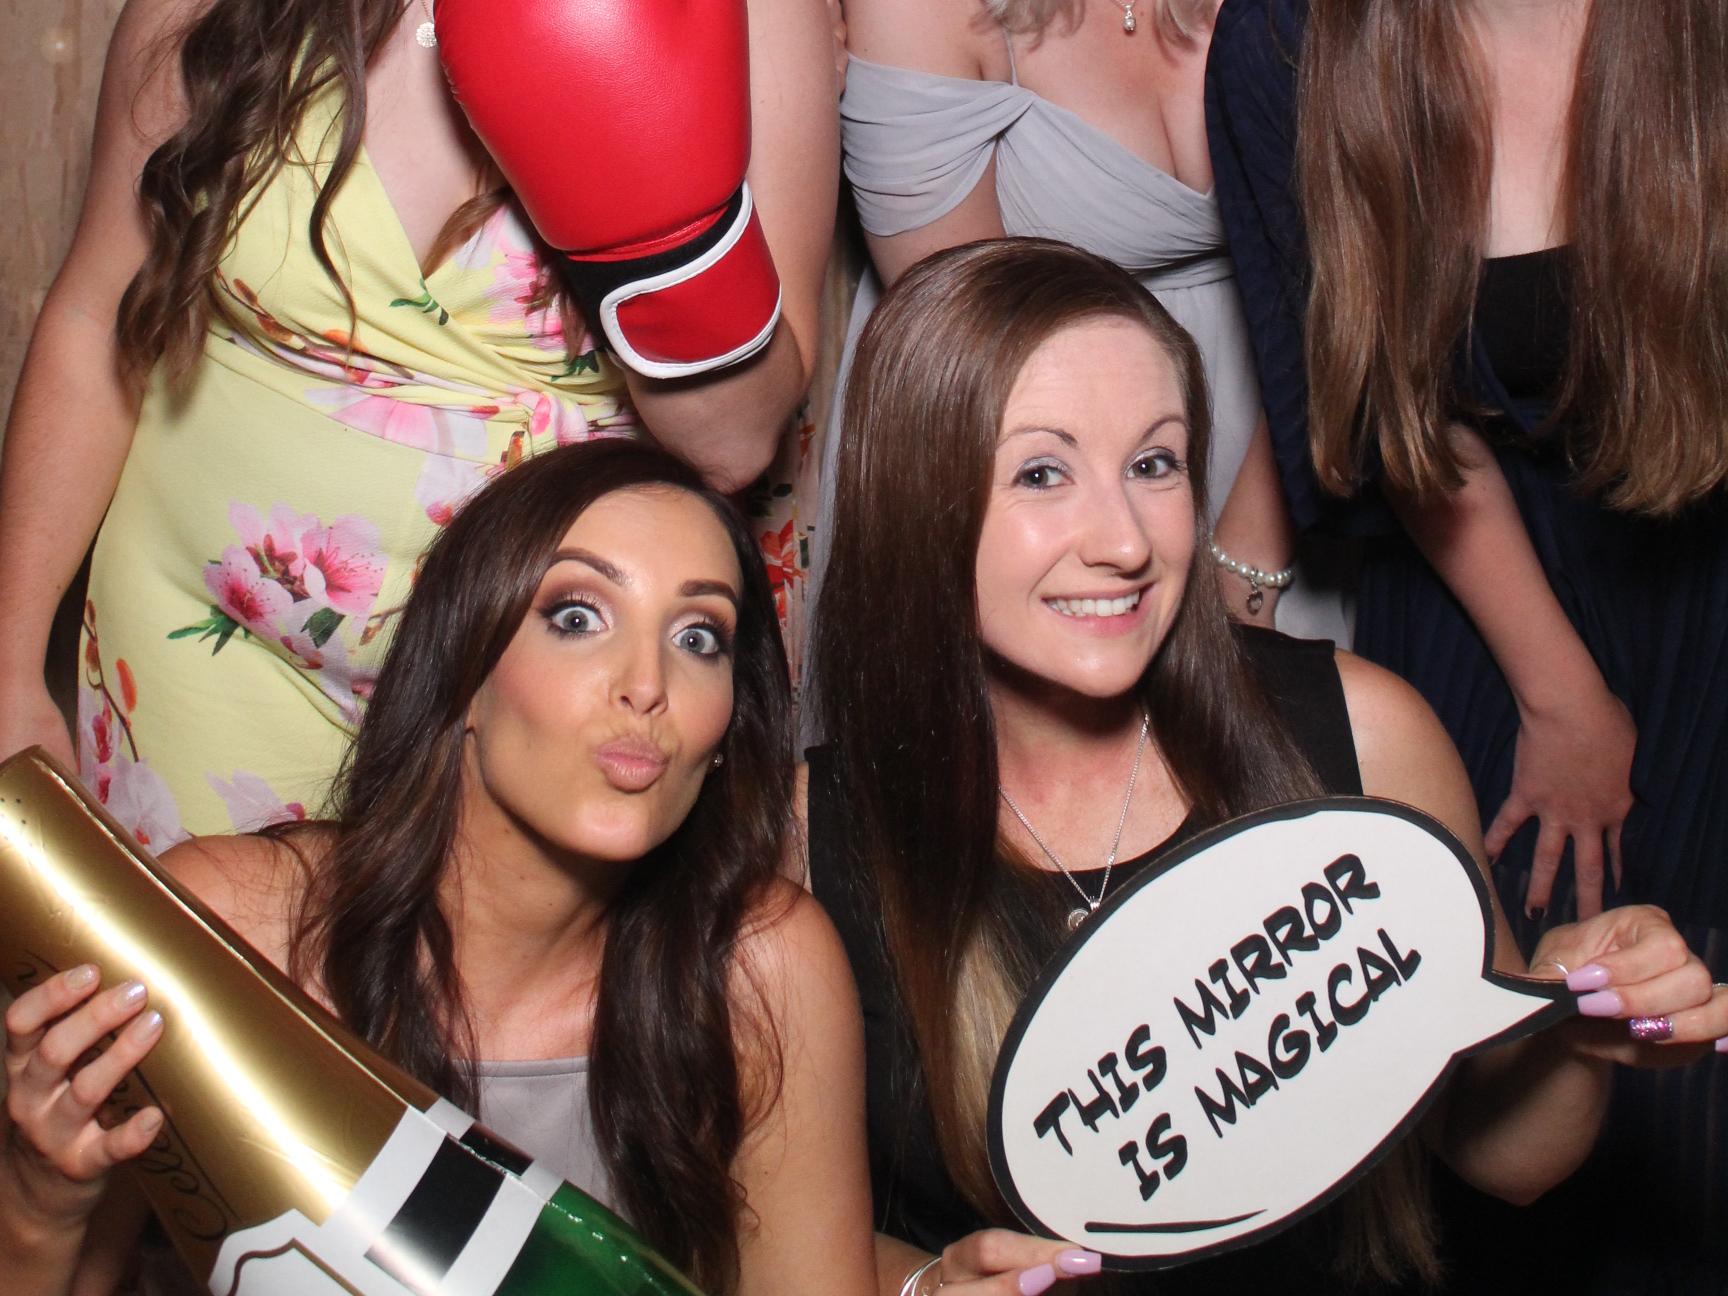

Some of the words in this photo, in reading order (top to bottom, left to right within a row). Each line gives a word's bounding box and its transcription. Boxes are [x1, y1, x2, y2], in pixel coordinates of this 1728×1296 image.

[1033, 1024, 1167, 1156] THIS
[1173, 853, 1381, 1050] MIRROR
[1118, 1112, 1188, 1202] IS
[1194, 928, 1422, 1139] MAGICAL
